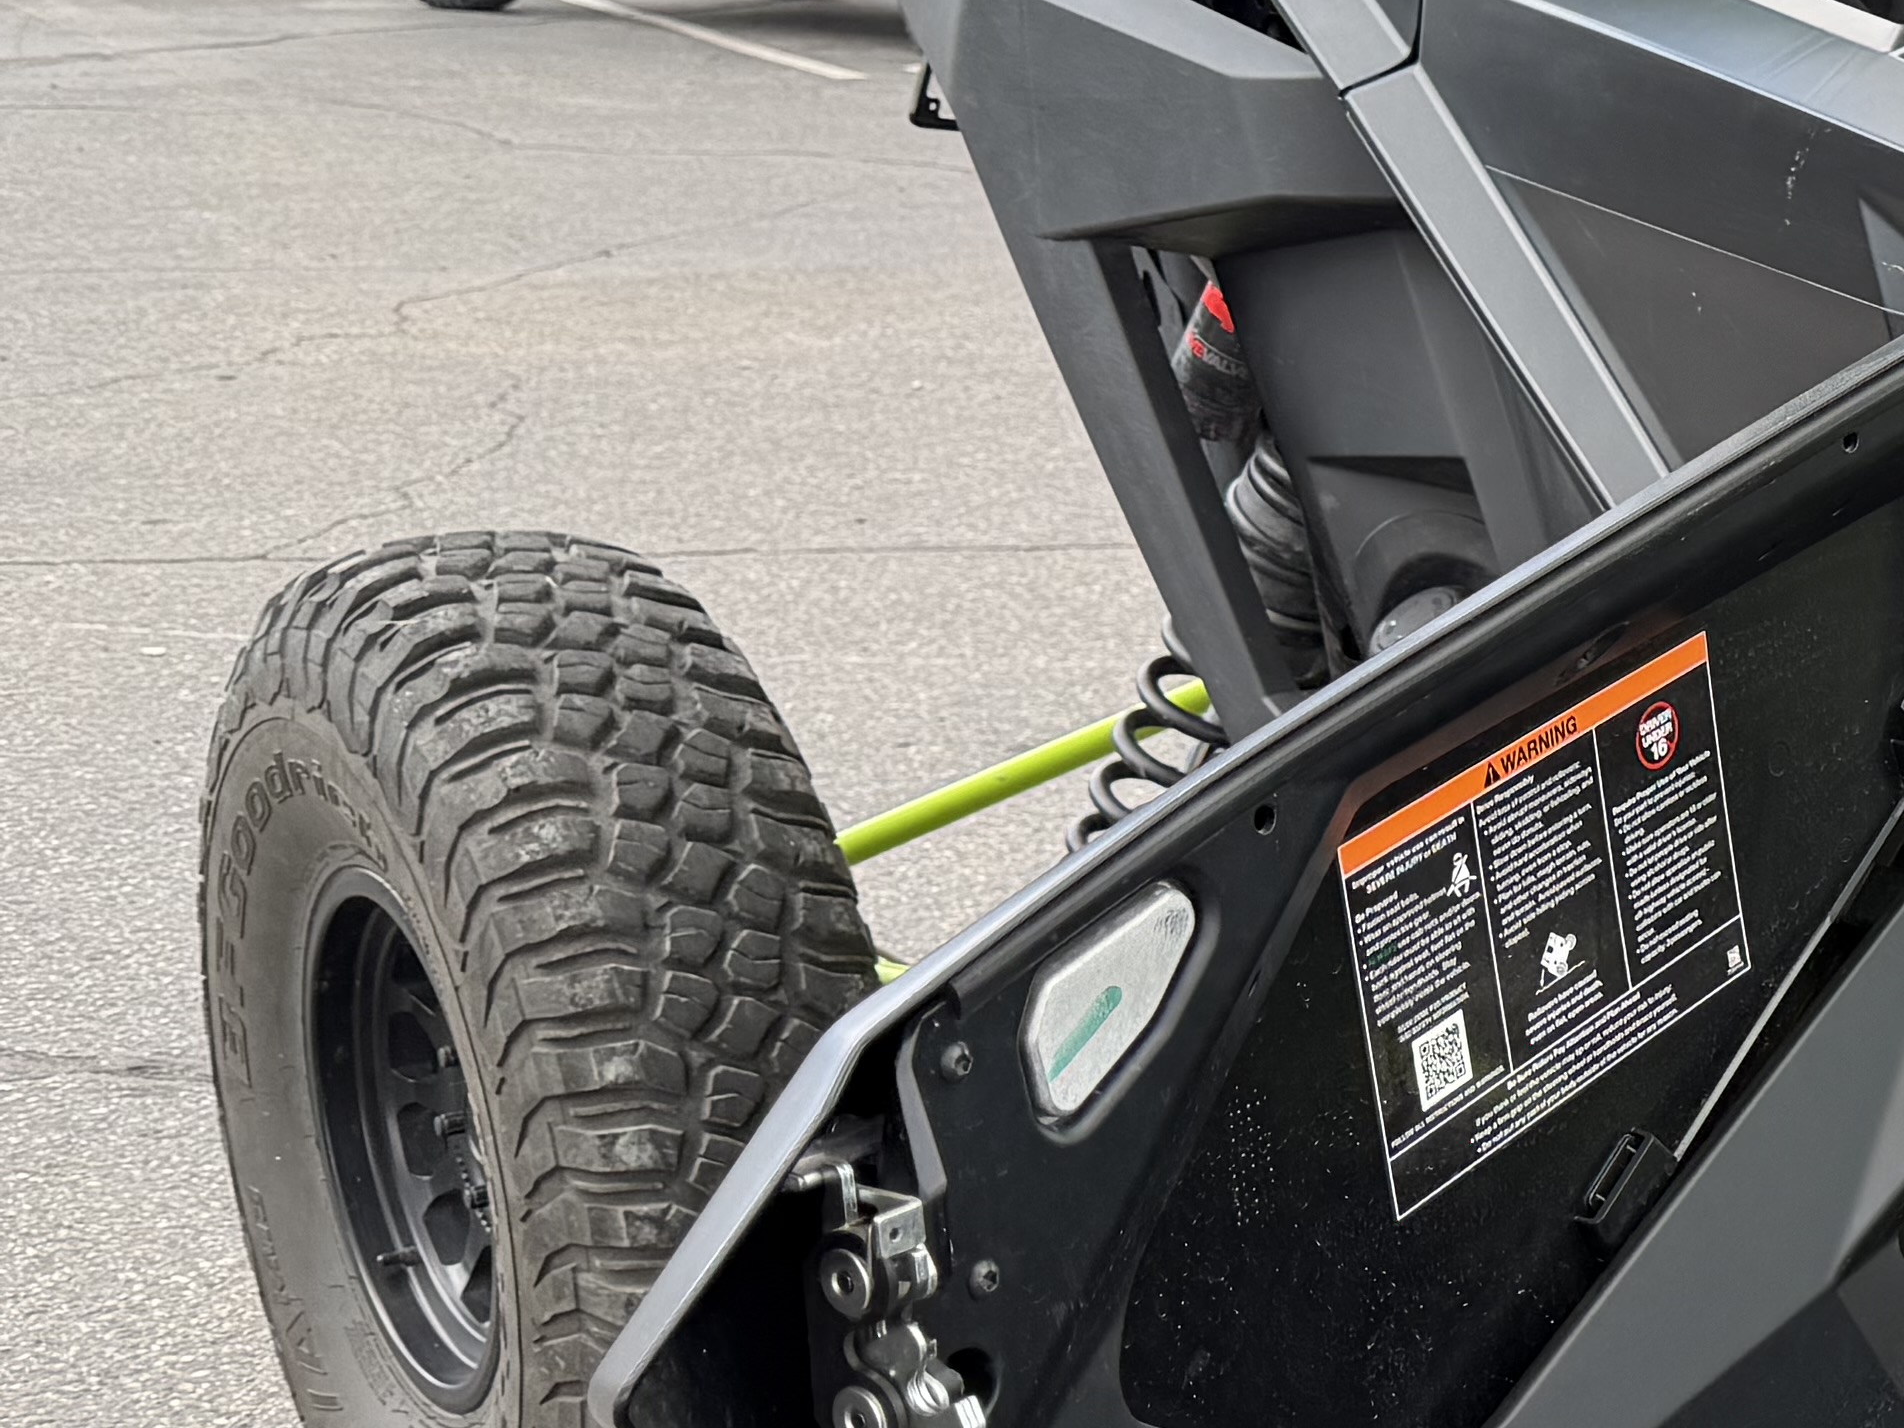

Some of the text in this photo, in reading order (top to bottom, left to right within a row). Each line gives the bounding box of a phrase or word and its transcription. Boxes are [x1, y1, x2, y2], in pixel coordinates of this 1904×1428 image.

[1639, 708, 1672, 737] DRIVER
[1641, 721, 1673, 749] UNDER
[1501, 715, 1578, 776] WARNING
[1650, 737, 1668, 760] 16
